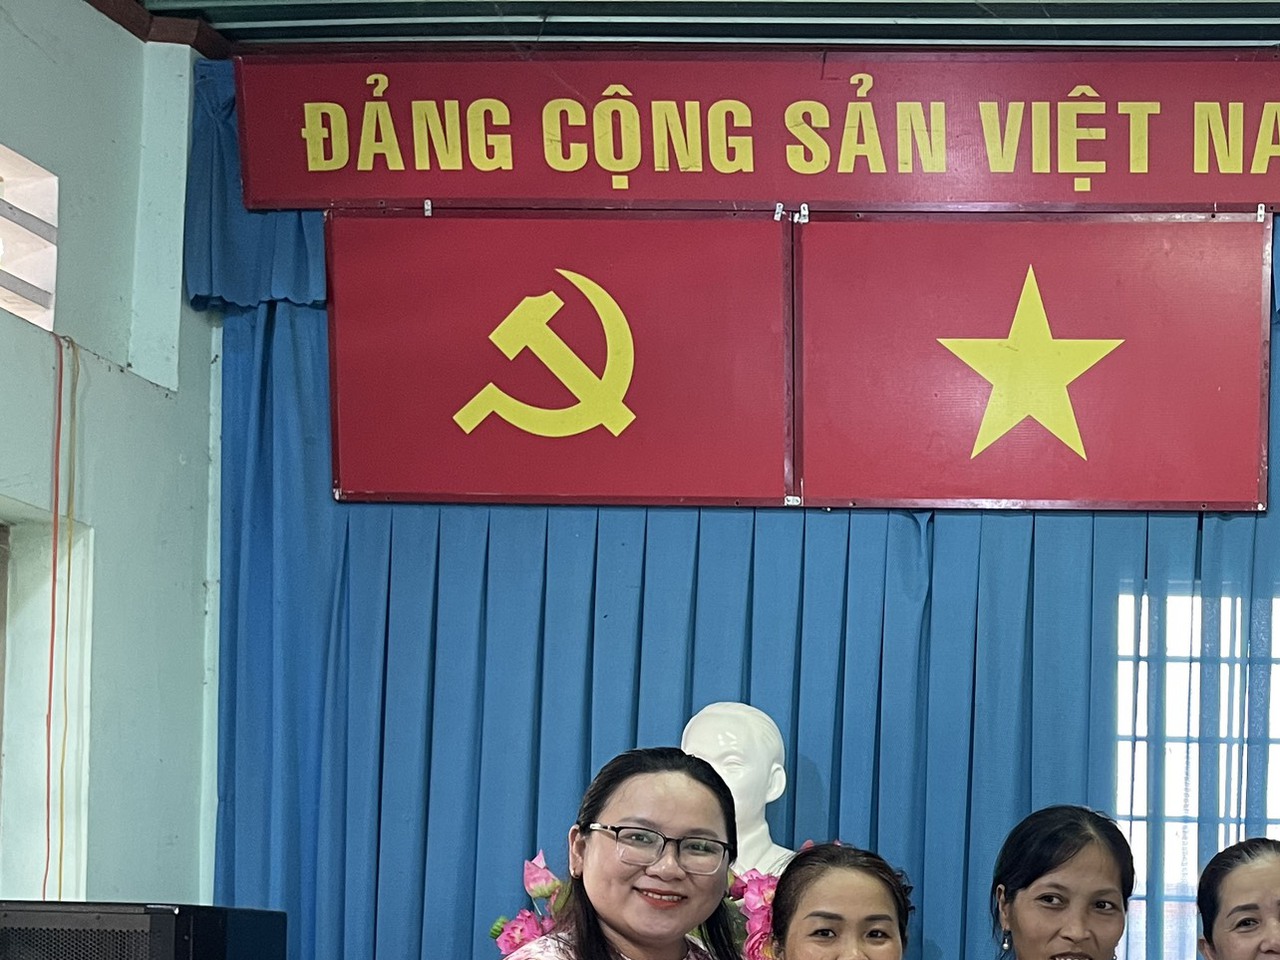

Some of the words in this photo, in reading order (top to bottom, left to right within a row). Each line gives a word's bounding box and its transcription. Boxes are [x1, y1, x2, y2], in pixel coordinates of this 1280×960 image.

[302, 73, 513, 172] ĐẢNG
[542, 84, 754, 190] CỘNG
[785, 75, 944, 174] SẢN
[981, 86, 1161, 192] VIỆT
